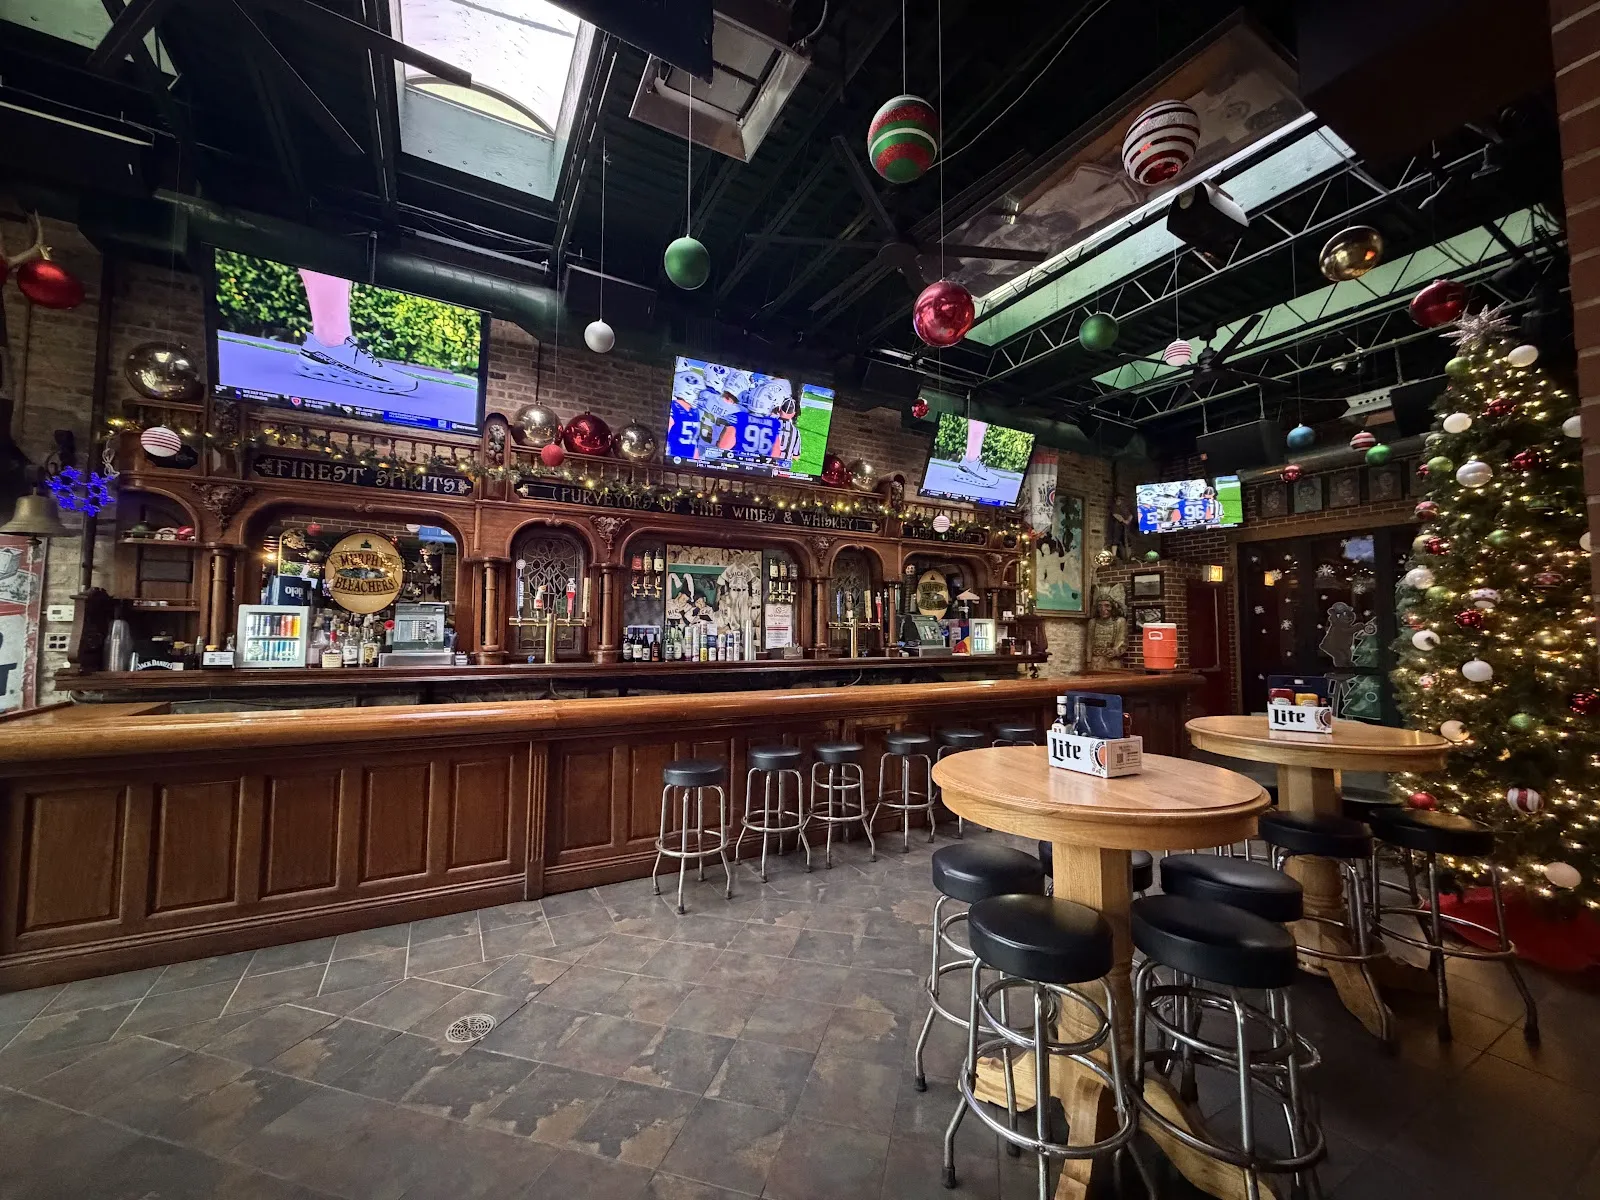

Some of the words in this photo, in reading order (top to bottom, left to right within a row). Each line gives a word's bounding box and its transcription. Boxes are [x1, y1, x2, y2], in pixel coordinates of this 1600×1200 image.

[742, 424, 773, 453] 96
[276, 460, 366, 484] FINEST
[561, 487, 652, 510] PURVEYORS
[732, 504, 776, 522] WINES
[783, 511, 793, 524] &
[800, 509, 853, 530] WHISKEY
[1184, 505, 1205, 520] 96
[334, 577, 395, 593] BLEACHERS
[1273, 709, 1306, 726] Lite
[1051, 737, 1081, 762] Lite
